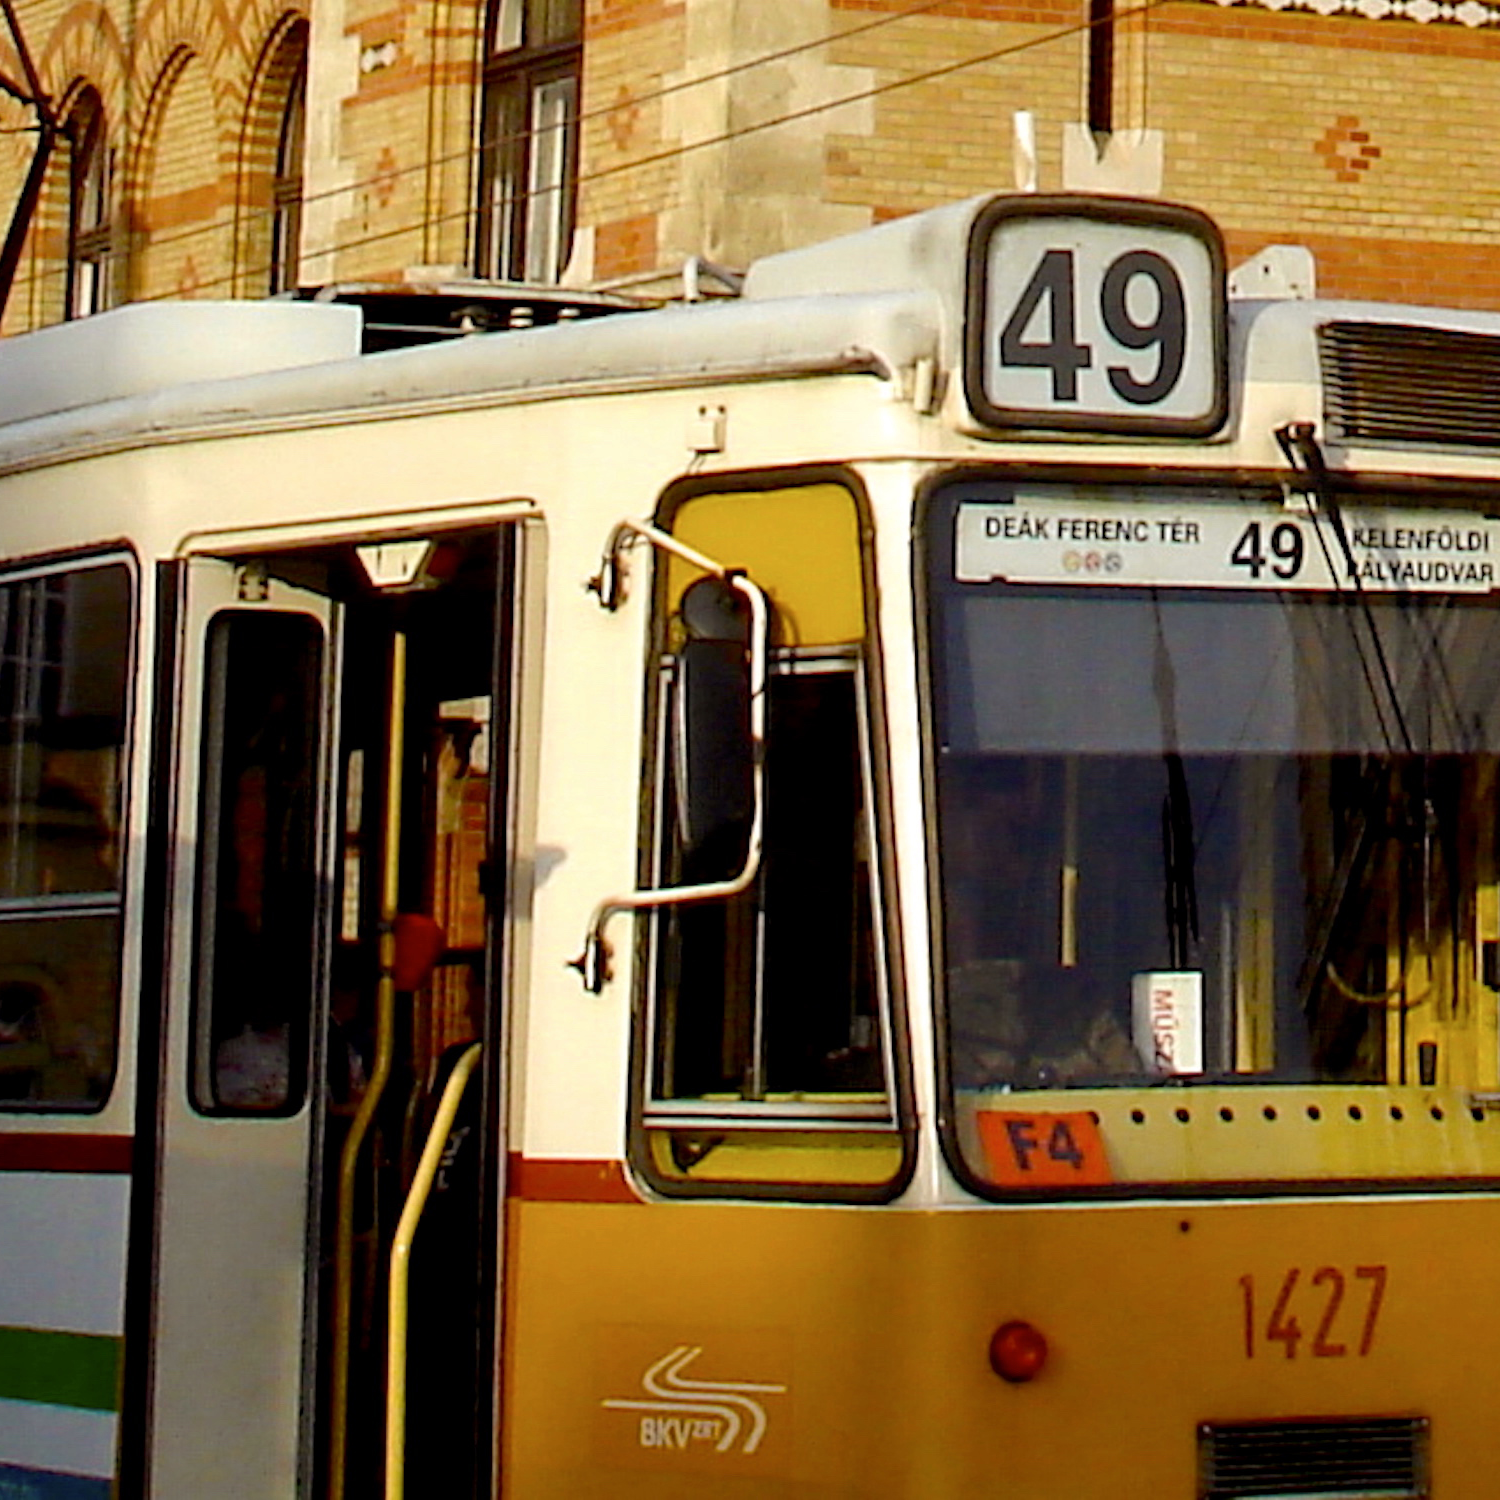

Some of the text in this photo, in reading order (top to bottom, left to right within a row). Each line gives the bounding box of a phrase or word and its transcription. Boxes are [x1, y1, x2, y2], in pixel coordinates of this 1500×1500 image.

[1000, 248, 1188, 404] 49
[985, 515, 1305, 580] DEÁK FERENC TÉR 49
[1352, 526, 1490, 553] KELENFÖLDI
[1004, 1118, 1085, 1172] F4
[1238, 1264, 1388, 1360] 1427
[640, 1417, 691, 1449] BKV
